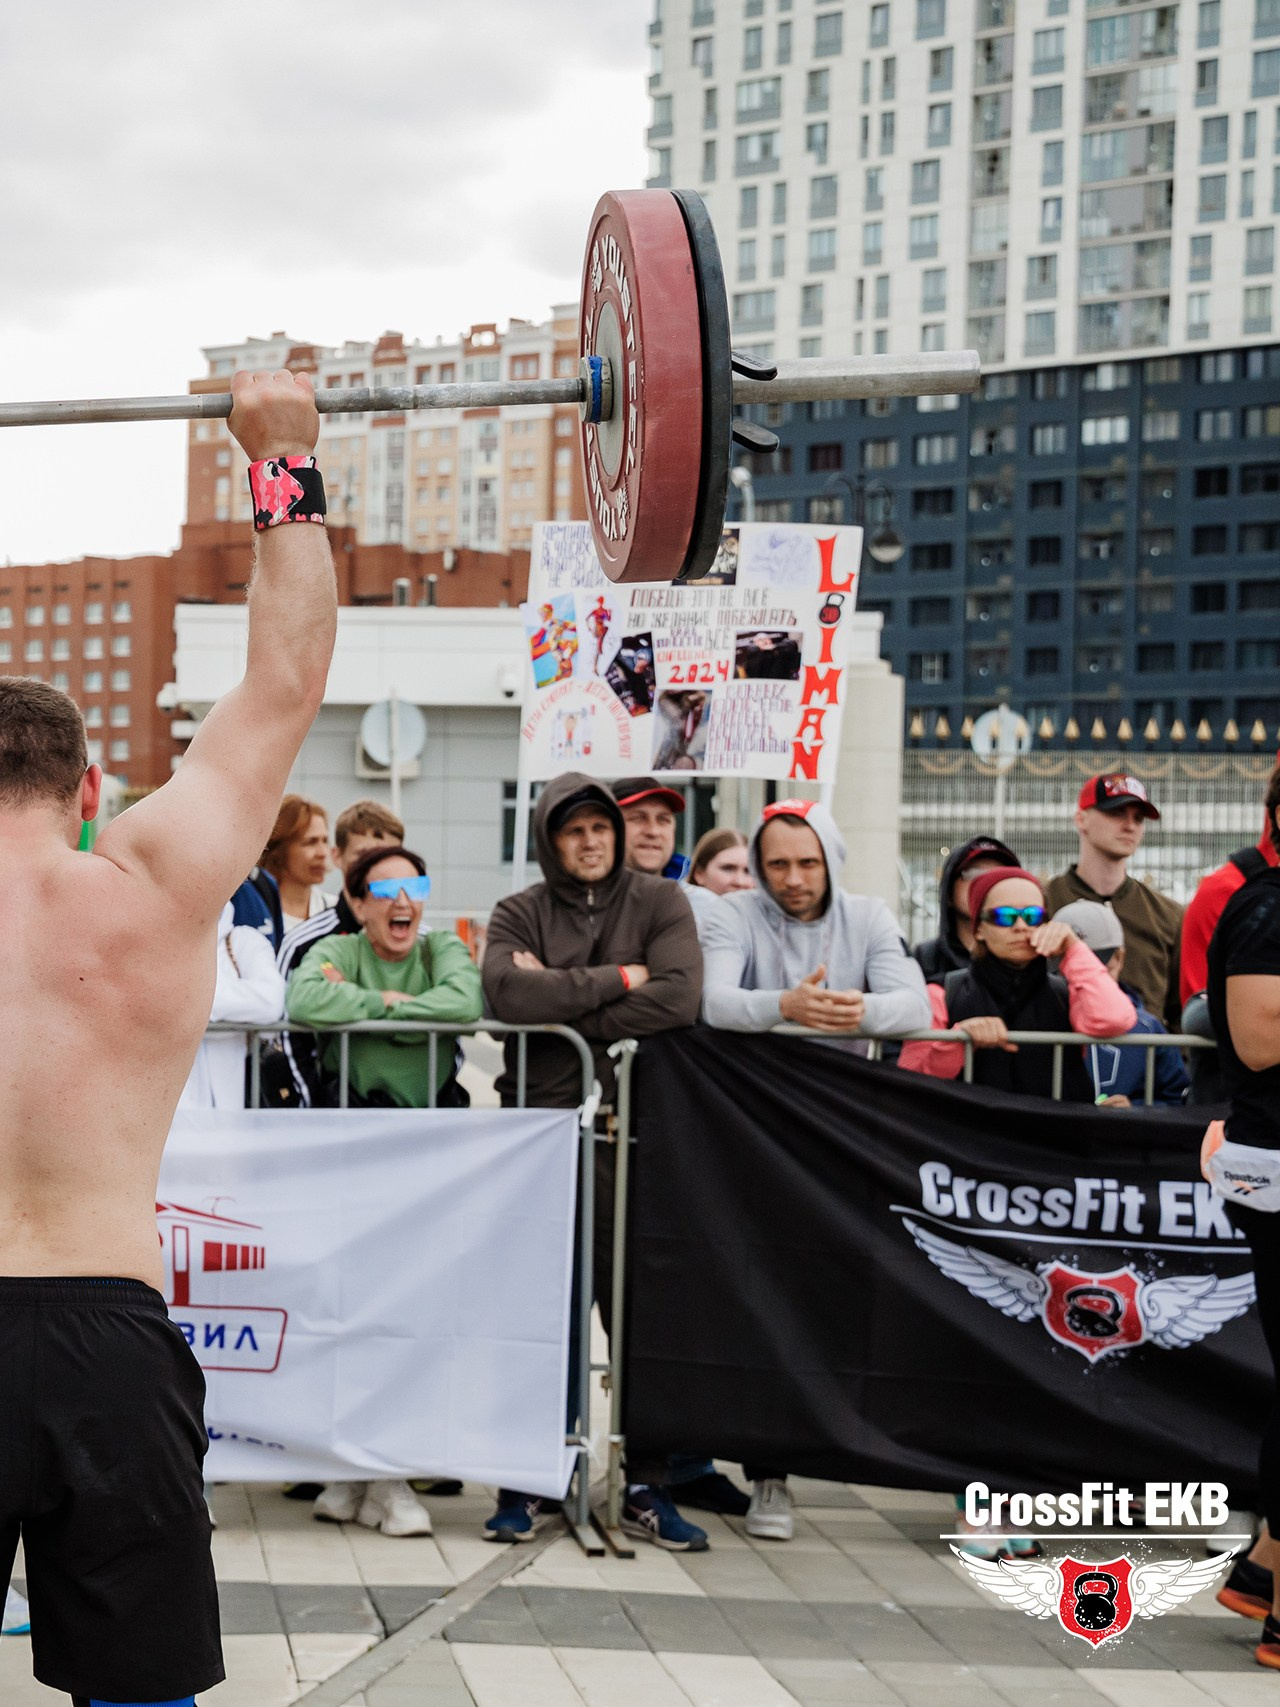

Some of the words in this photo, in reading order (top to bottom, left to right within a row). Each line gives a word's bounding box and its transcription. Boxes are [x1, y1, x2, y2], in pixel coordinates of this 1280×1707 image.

[669, 660, 730, 683] 2024
[919, 1161, 1145, 1235] CrossFit
[1158, 1180, 1246, 1240] EK
